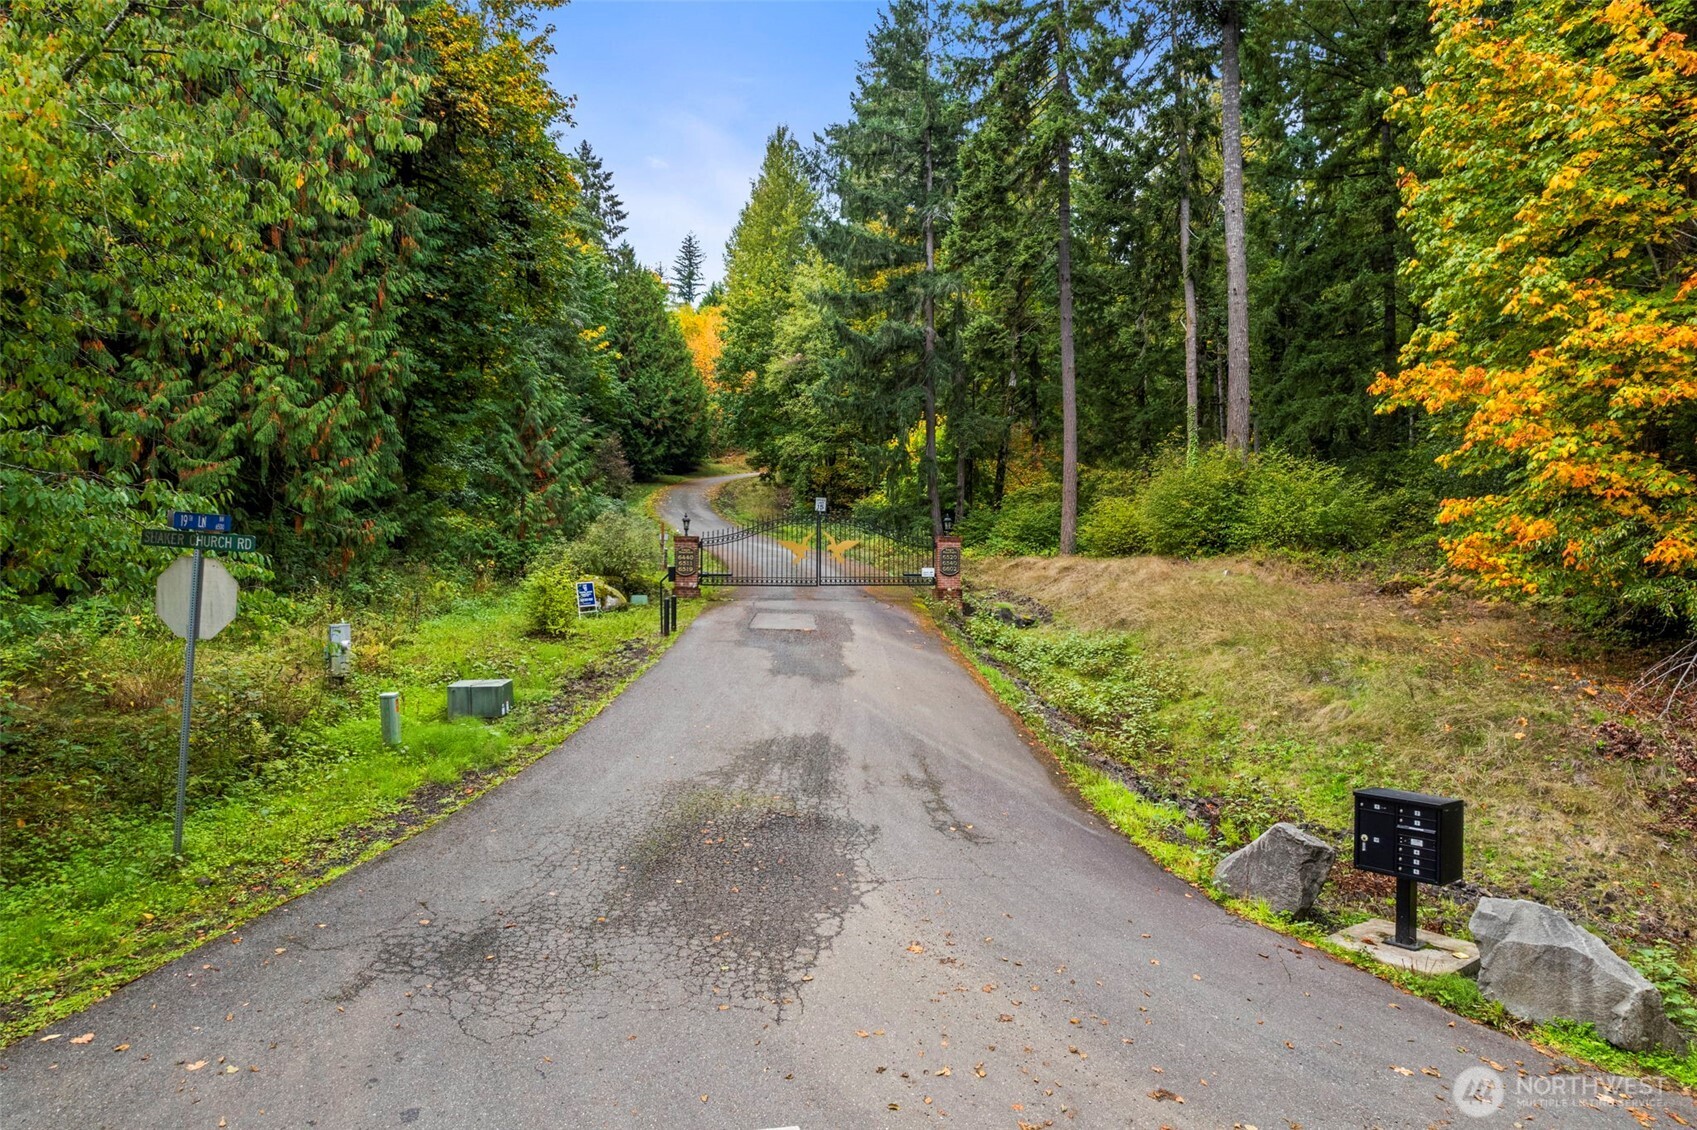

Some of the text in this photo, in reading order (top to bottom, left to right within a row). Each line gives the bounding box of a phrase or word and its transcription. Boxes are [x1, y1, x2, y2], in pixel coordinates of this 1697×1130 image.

[197, 515, 207, 528] LN
[144, 530, 252, 550] SHAKER CHURCH RD
